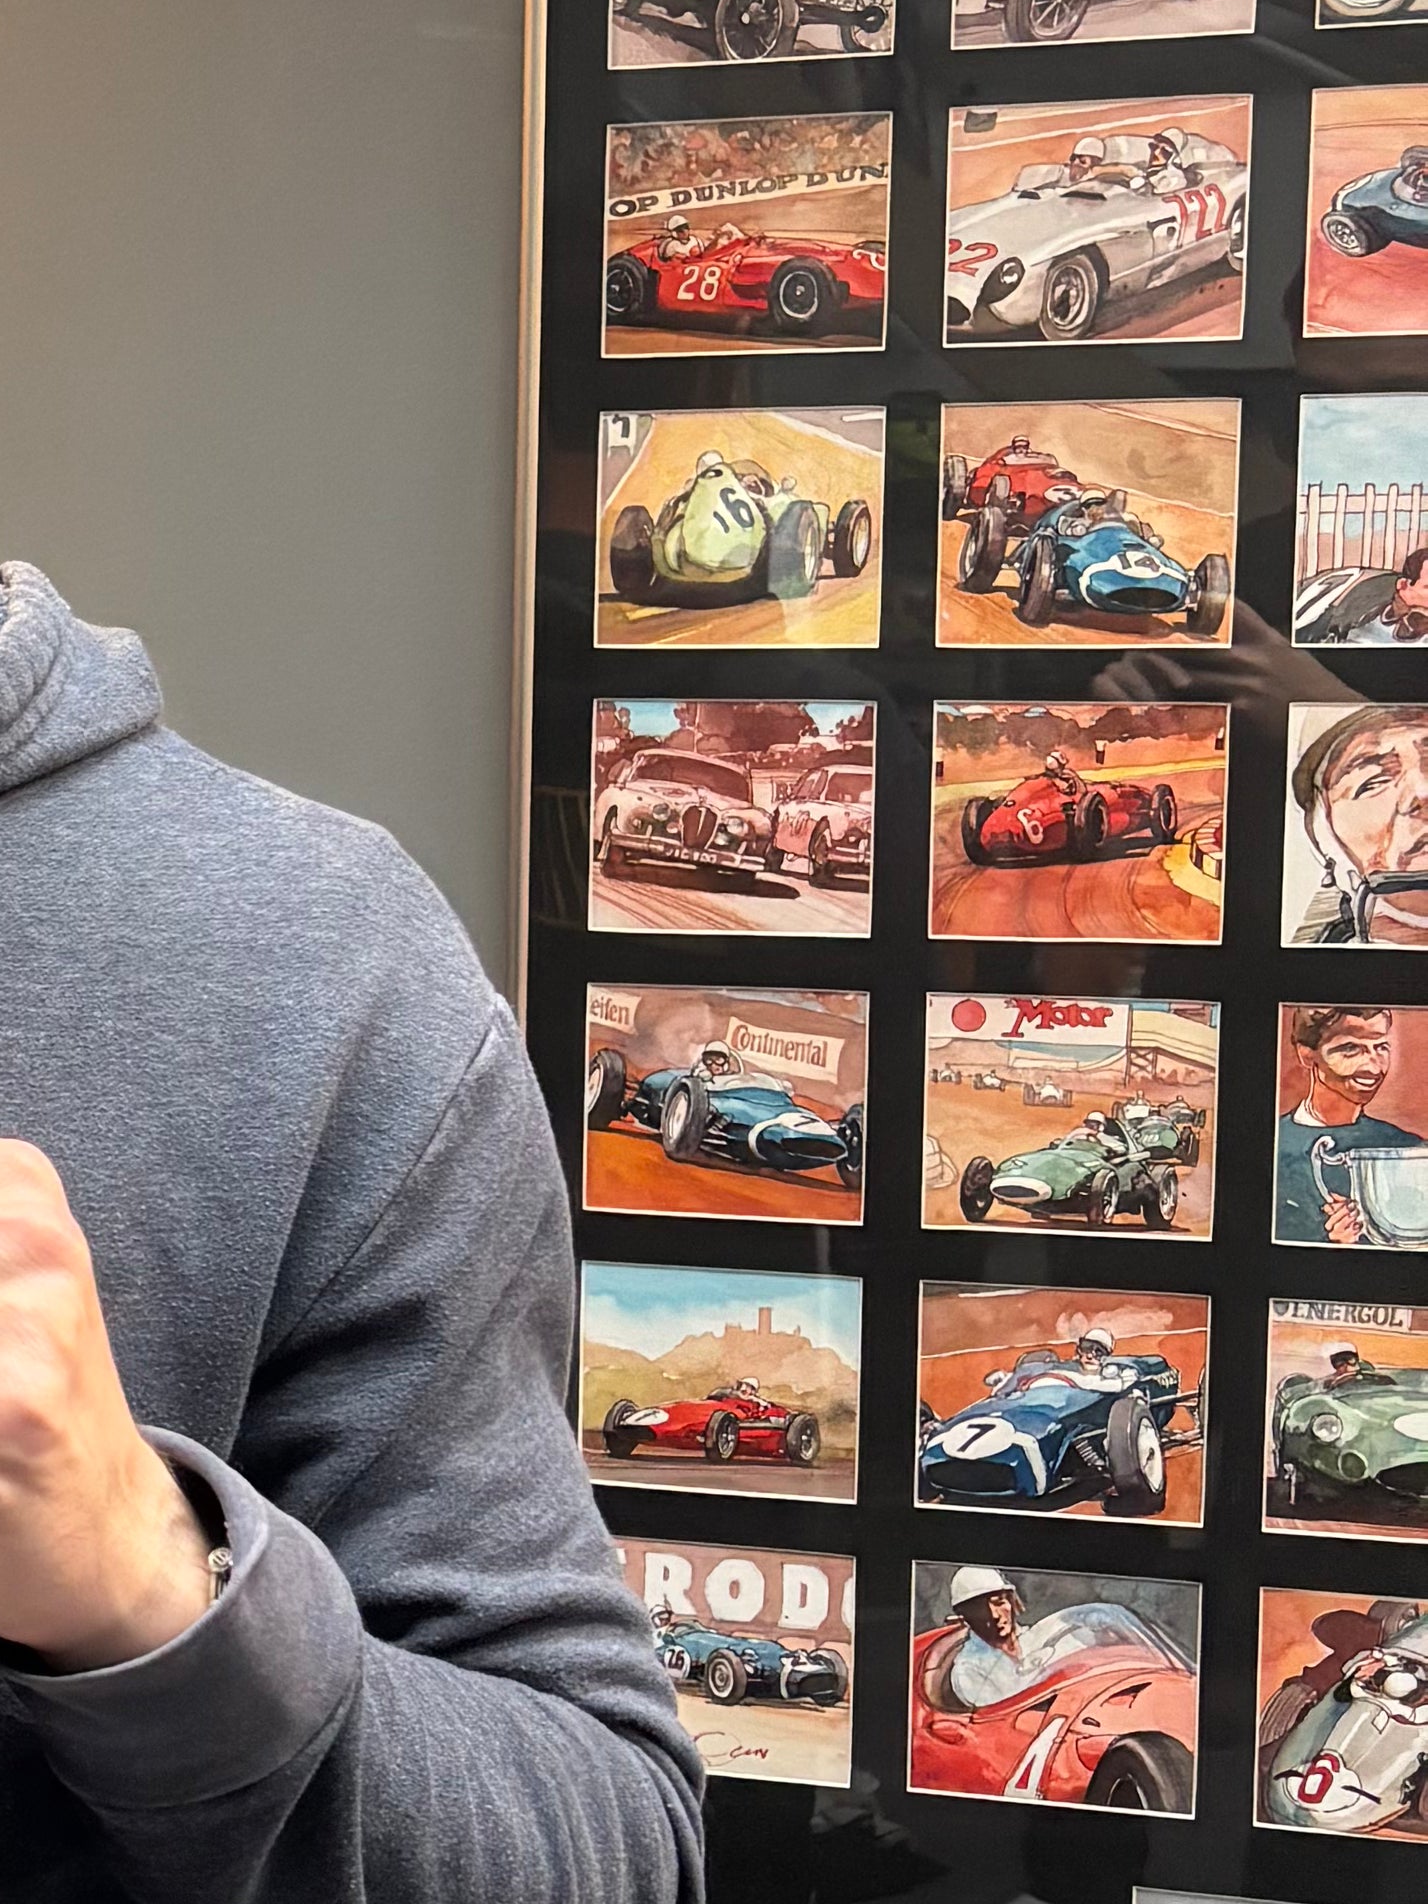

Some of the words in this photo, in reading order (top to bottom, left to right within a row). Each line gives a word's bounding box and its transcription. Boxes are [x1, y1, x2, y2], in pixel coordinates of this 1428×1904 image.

[610, 196, 659, 218] OP
[670, 173, 799, 208] DUNLOP
[1152, 183, 1228, 250] 722
[677, 266, 722, 301] 28
[713, 487, 755, 534] 16
[1001, 998, 1114, 1038] Motor
[731, 1024, 829, 1069] Continental
[957, 1423, 995, 1454] 7
[616, 1548, 855, 1633] ROD
[667, 1649, 686, 1671] 26
[1297, 1752, 1341, 1804] 6
